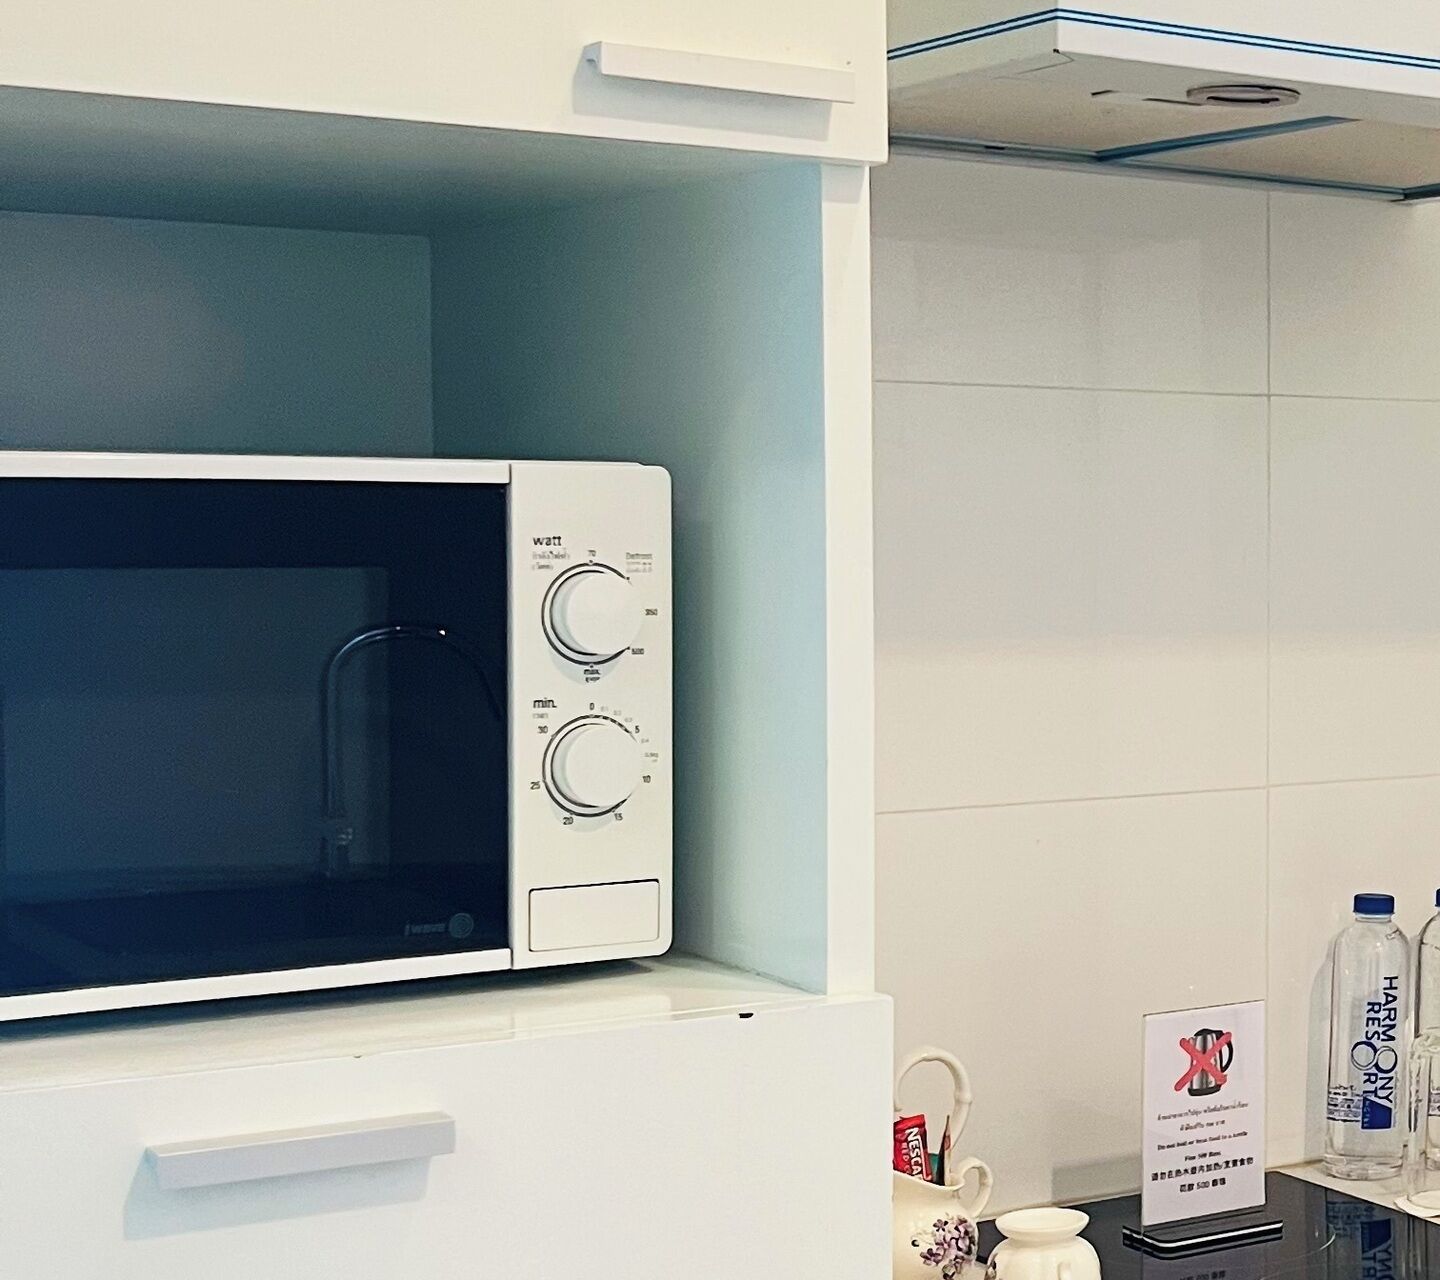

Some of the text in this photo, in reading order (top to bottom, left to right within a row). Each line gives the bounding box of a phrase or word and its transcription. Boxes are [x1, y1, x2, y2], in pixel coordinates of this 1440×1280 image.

[533, 535, 562, 546] watt
[533, 697, 557, 708] min.
[537, 725, 549, 734] 30
[634, 724, 641, 734] 5
[642, 775, 652, 784] 10
[530, 780, 541, 790] 25
[562, 816, 574, 825] 20
[614, 812, 624, 821] 15
[1373, 975, 1398, 1104] HARMONY
[1351, 1001, 1382, 1098] RESORT
